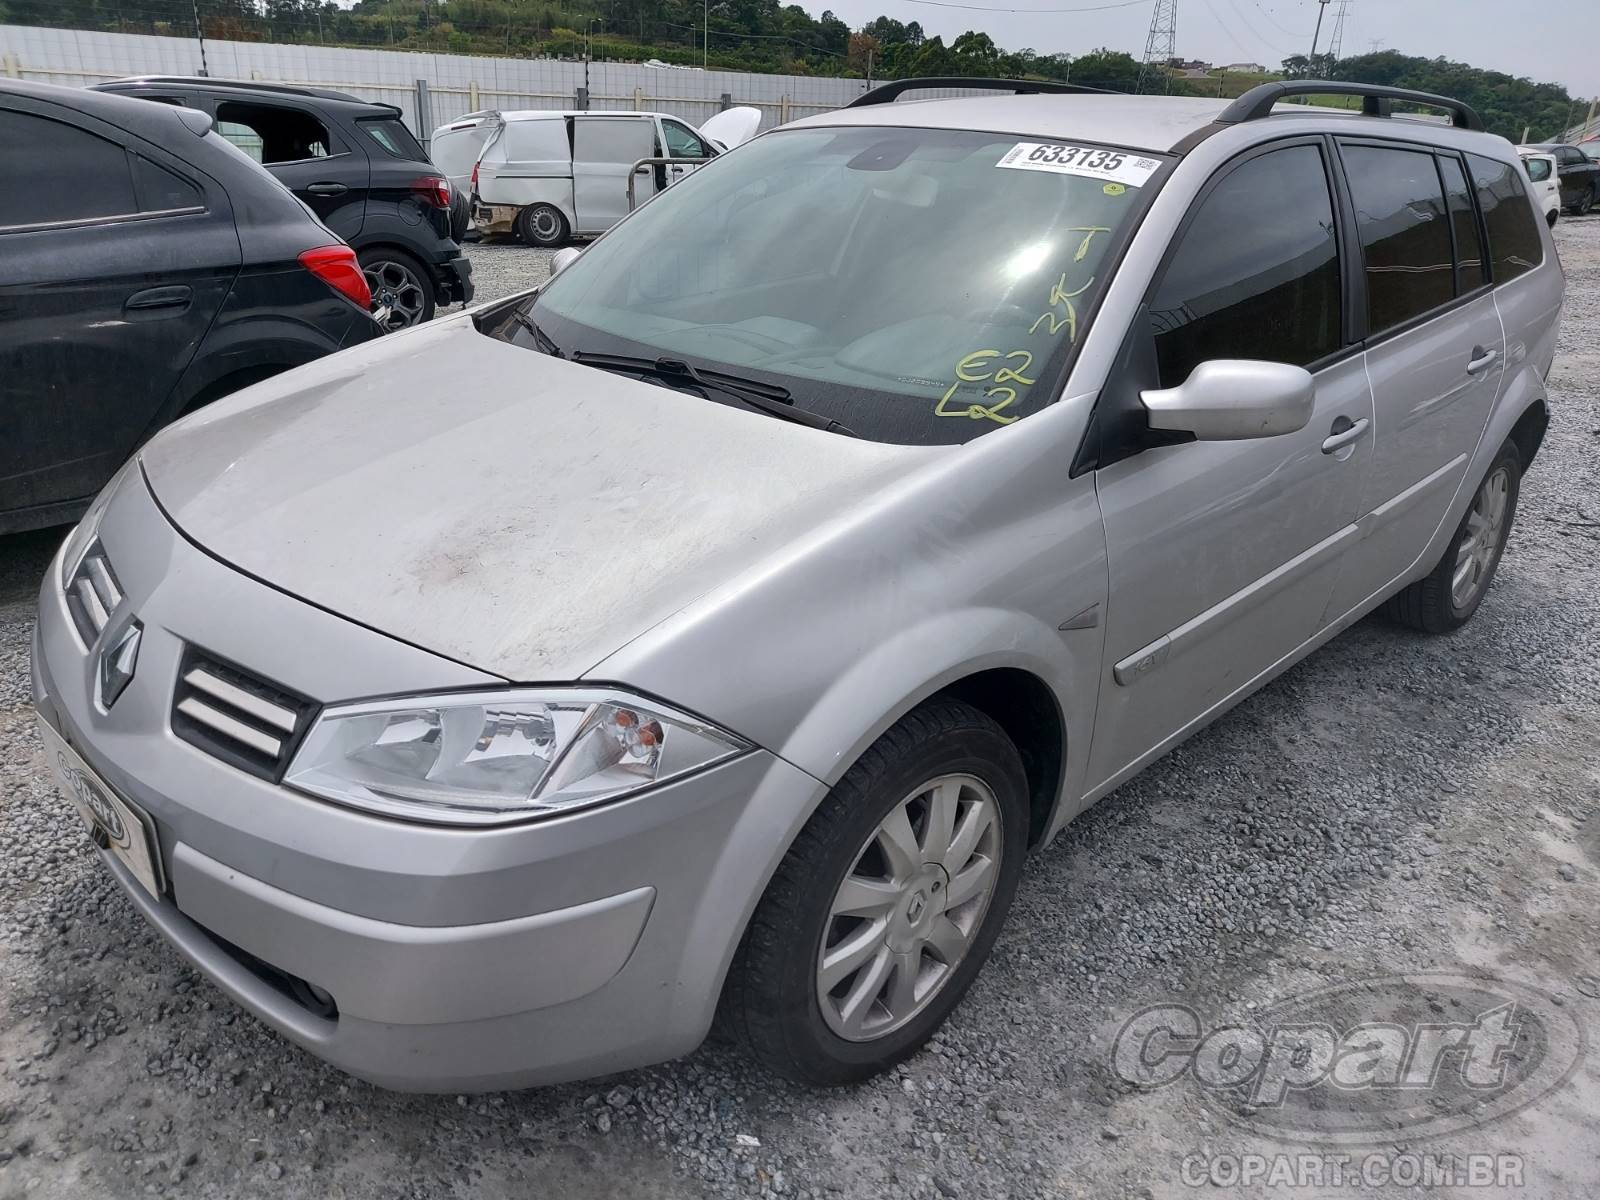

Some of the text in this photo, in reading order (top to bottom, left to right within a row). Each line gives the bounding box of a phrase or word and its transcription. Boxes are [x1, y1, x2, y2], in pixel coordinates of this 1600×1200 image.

[1028, 145, 1127, 171] 633135
[955, 349, 1036, 385] E2
[934, 381, 1020, 425] L2
[57, 751, 122, 836] Copart
